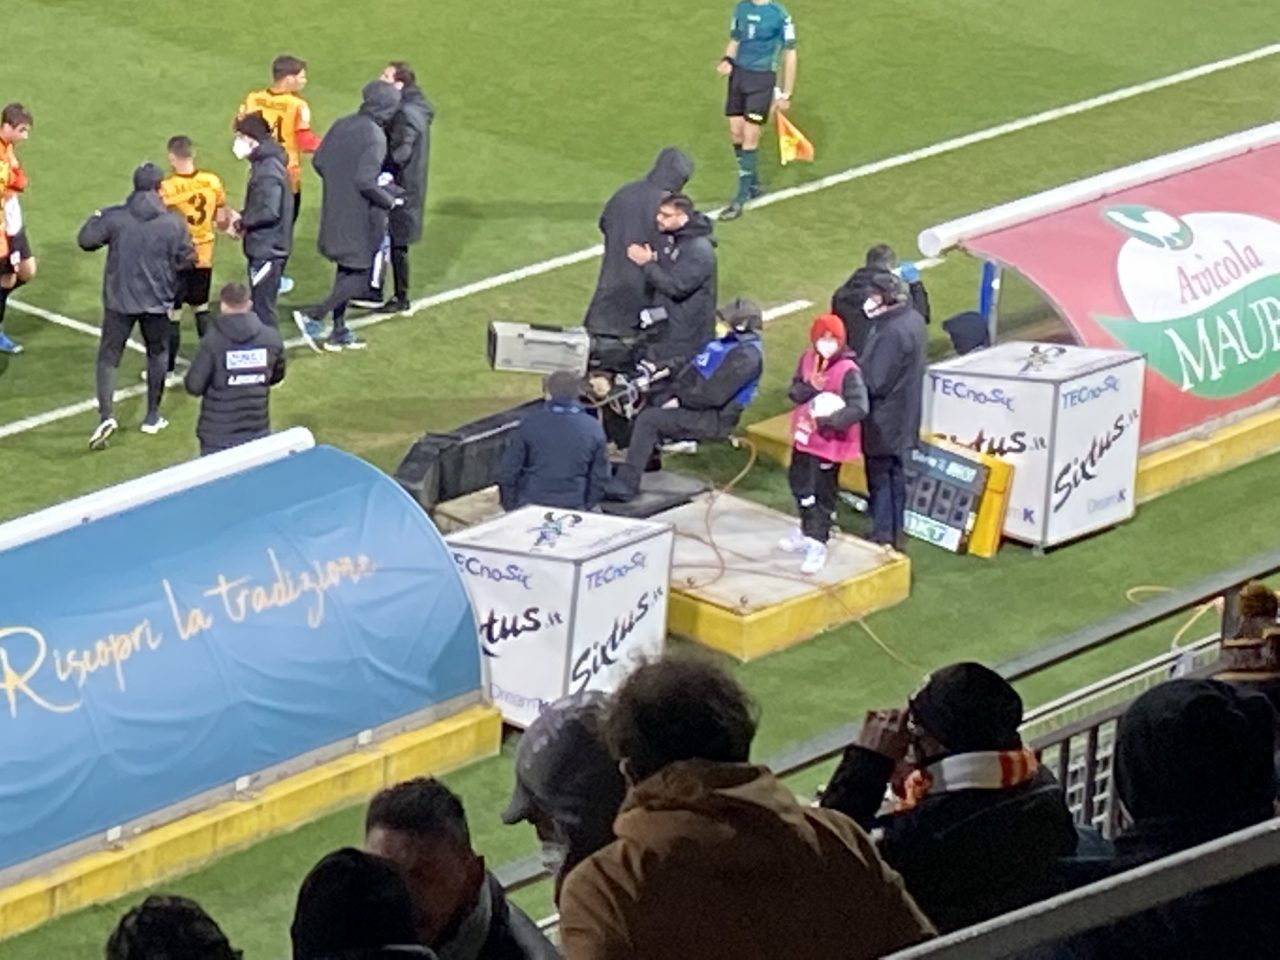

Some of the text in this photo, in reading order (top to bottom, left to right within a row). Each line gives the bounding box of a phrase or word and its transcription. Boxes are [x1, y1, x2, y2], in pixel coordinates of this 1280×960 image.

[186, 192, 207, 226] 3
[1177, 239, 1264, 305] Avicola
[163, 579, 214, 641] la
[203, 547, 376, 629] tradizione
